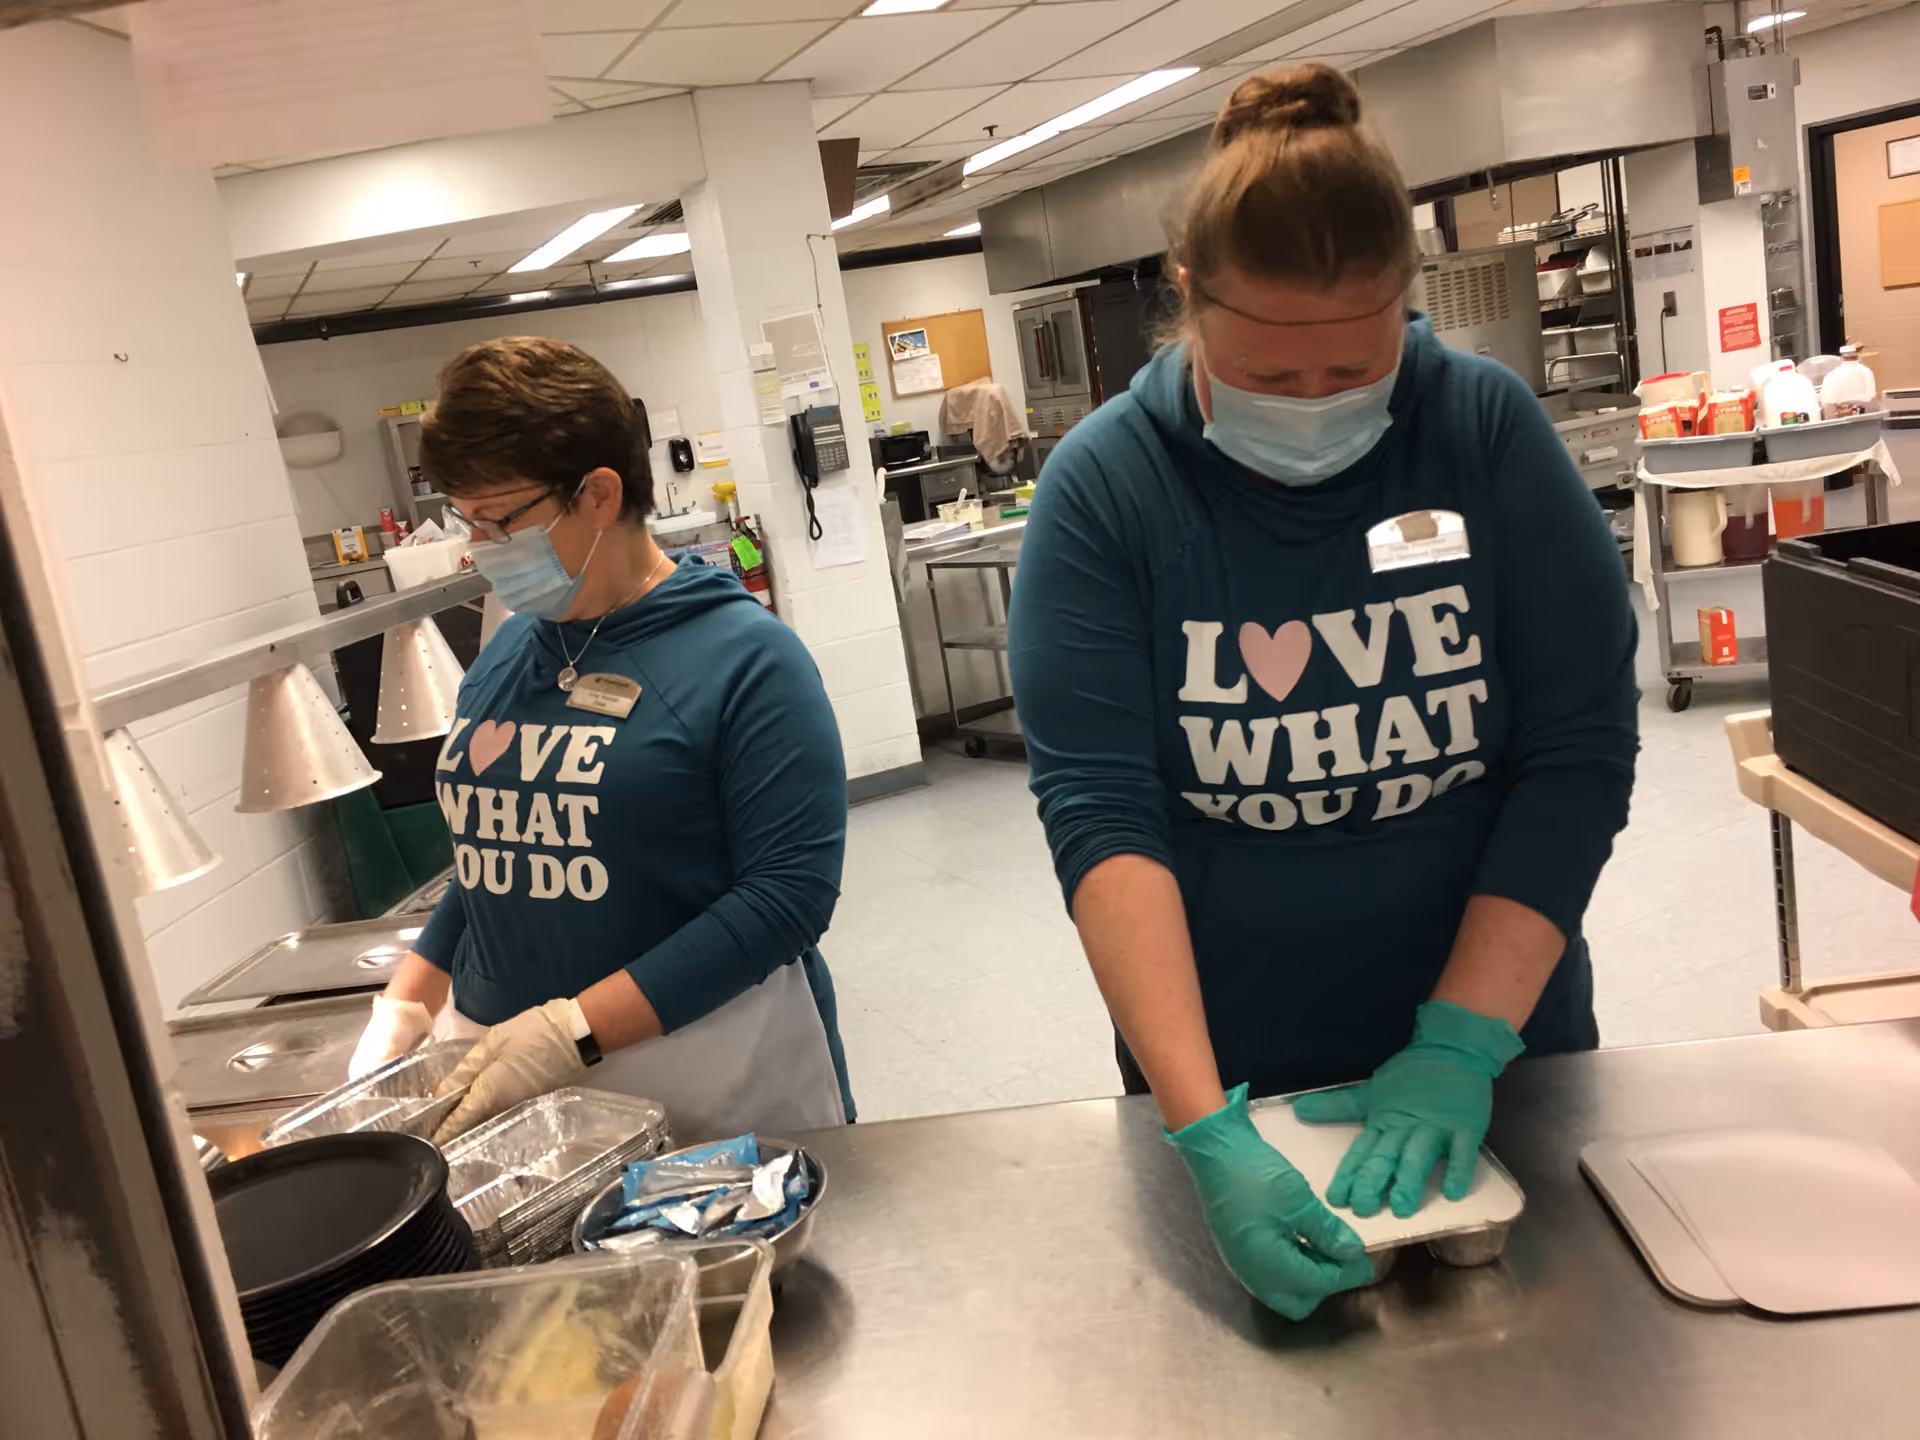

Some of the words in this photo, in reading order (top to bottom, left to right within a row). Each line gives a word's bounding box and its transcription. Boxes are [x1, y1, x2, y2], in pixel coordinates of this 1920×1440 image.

[1178, 679, 1488, 786] WHAT
[435, 781, 599, 848] WHAT
[1180, 786, 1358, 830] YOU
[454, 842, 515, 895] OU
[528, 853, 609, 901] DO
